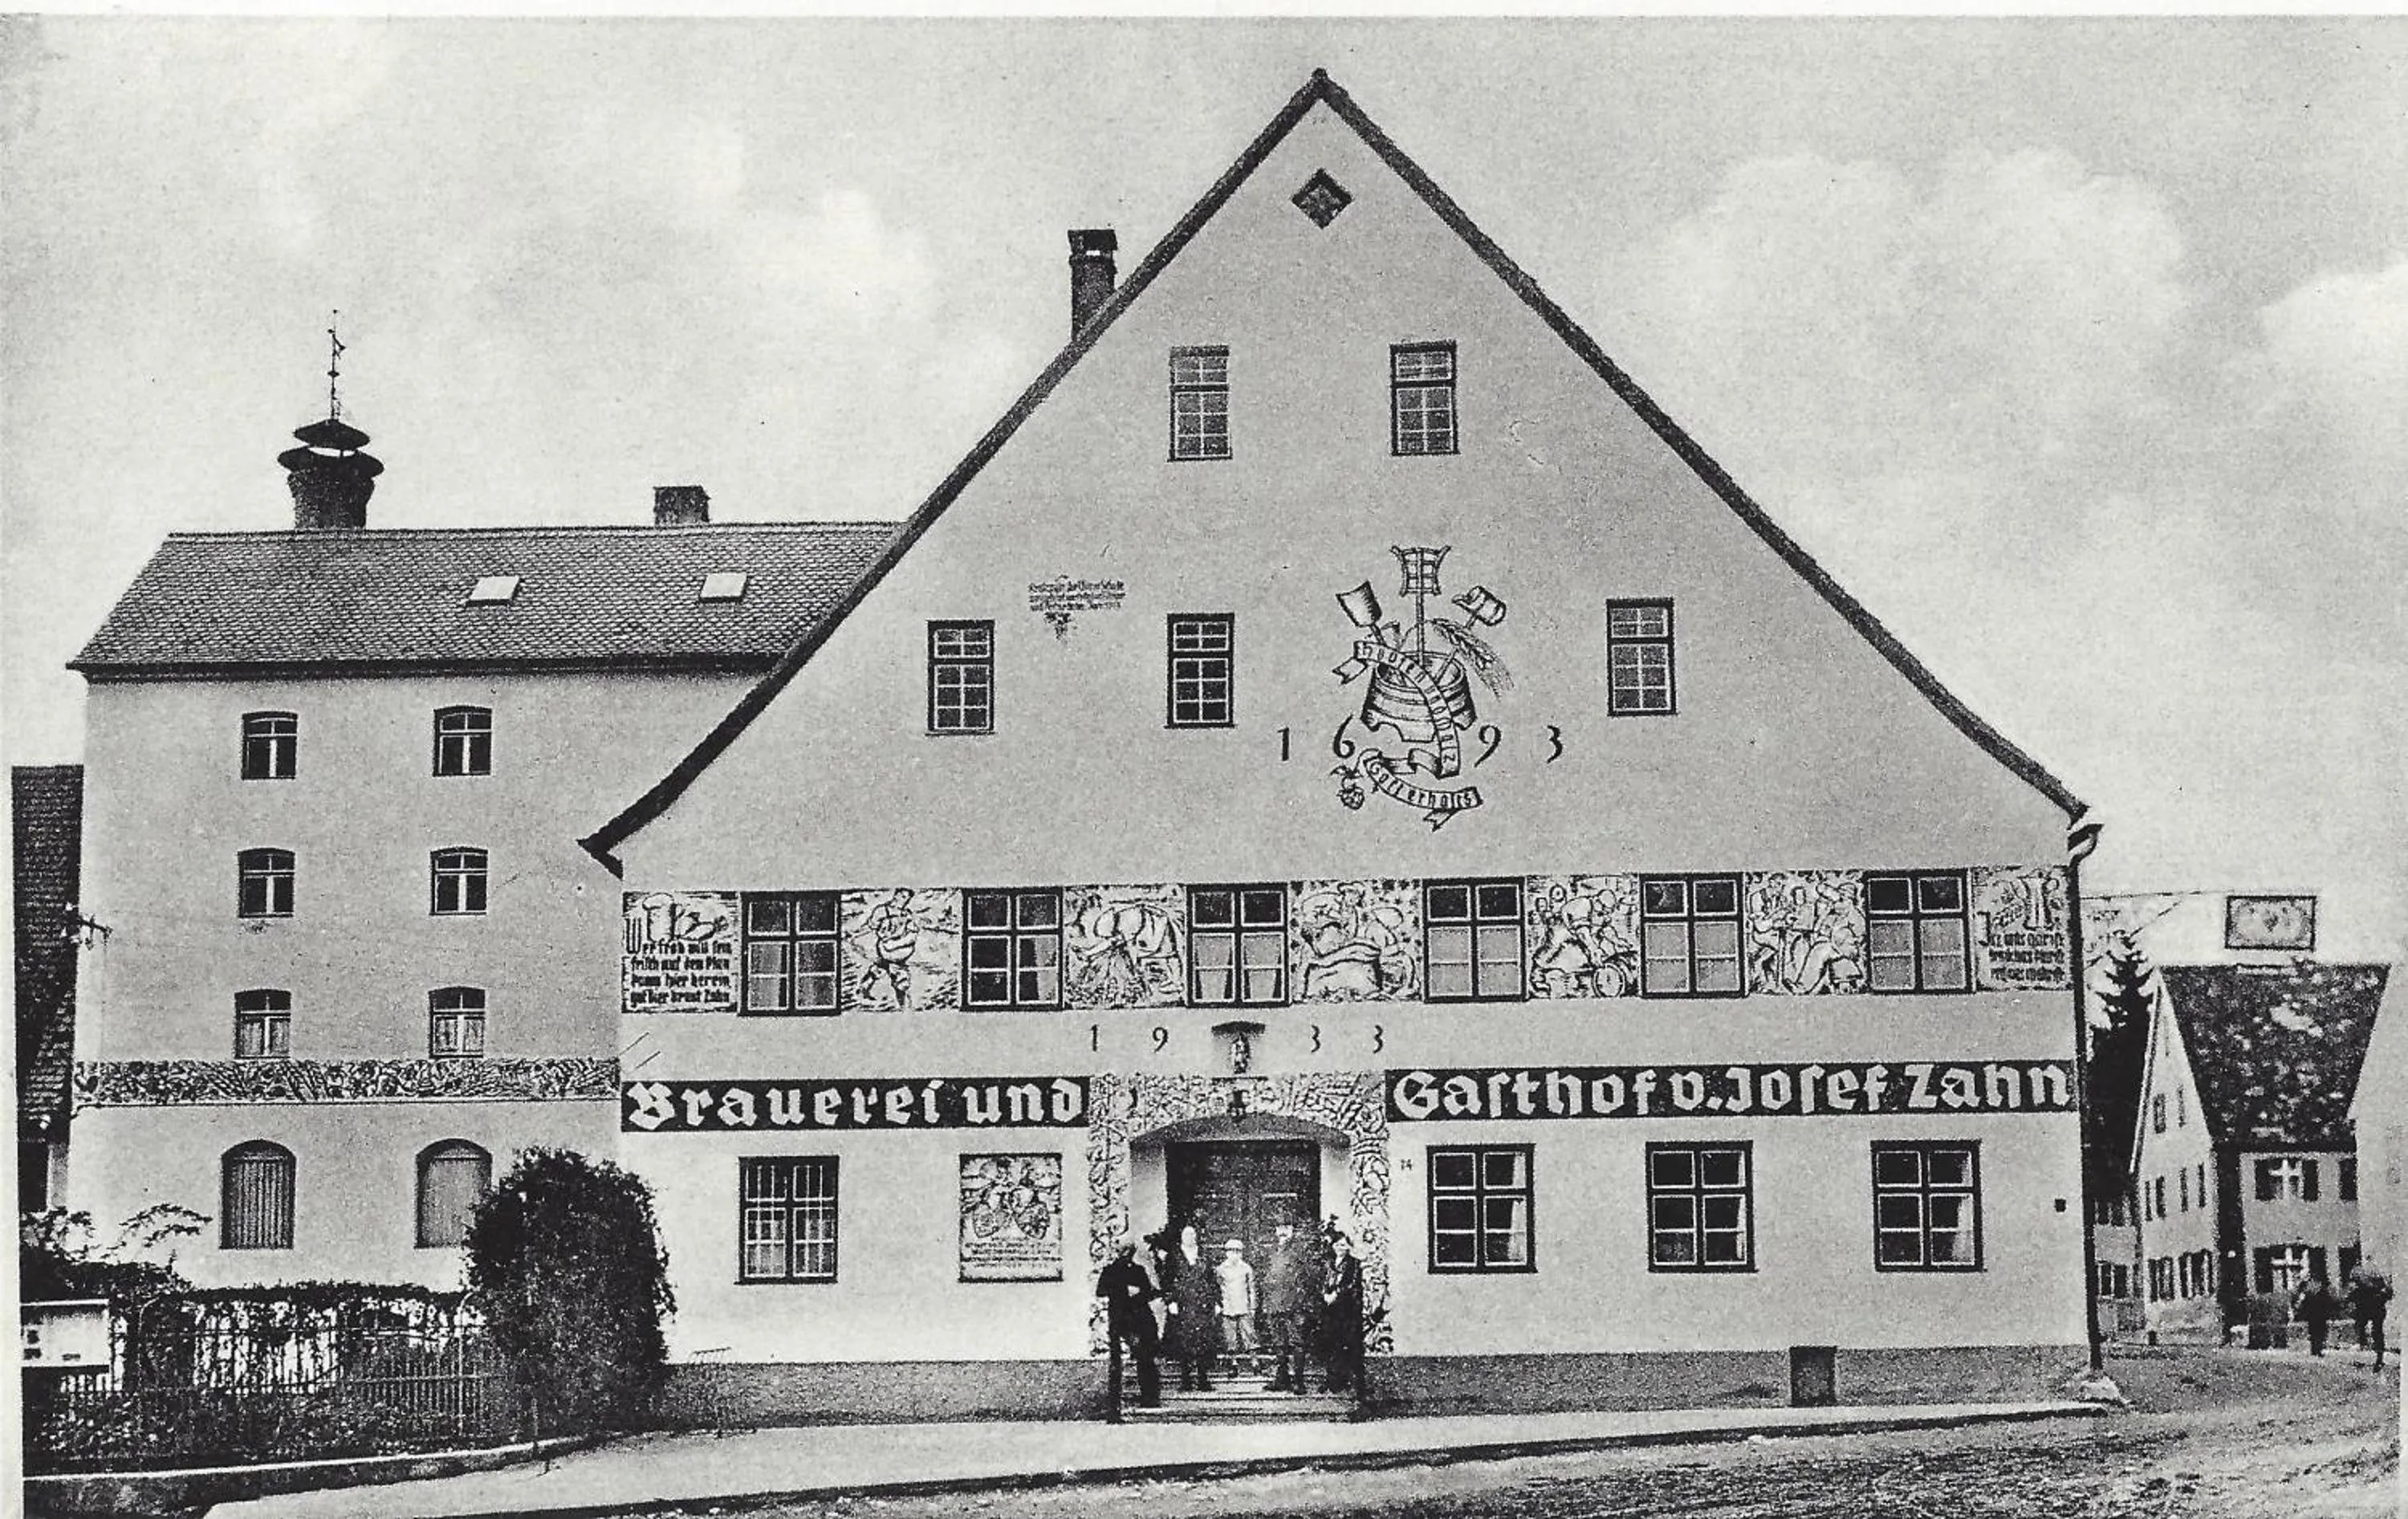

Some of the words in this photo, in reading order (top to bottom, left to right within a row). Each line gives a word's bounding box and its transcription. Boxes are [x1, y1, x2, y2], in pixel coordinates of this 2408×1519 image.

[626, 1080, 945, 1130] Brauerei
[963, 1077, 1082, 1125] und
[1393, 1069, 1658, 1120] Gasthof
[1904, 1063, 2070, 1110] Zahn
